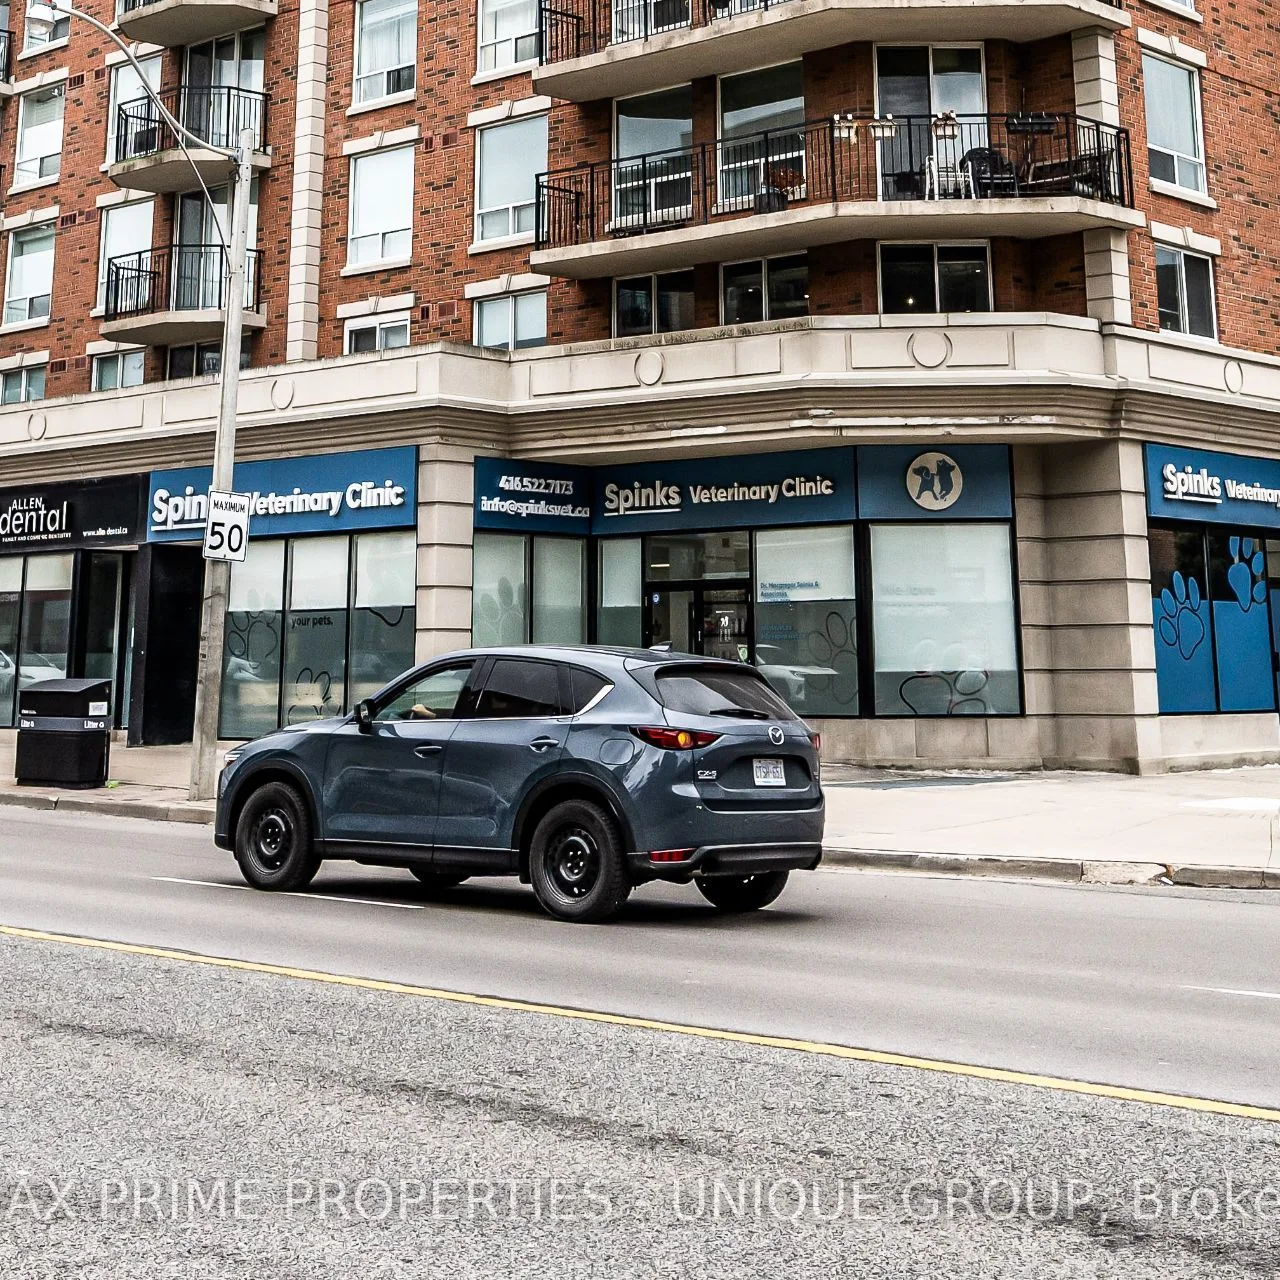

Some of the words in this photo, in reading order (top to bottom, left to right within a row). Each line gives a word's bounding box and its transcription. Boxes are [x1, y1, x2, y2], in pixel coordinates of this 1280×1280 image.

[499, 475, 573, 495] 416.522.7173
[1163, 463, 1222, 499] Spinks
[11, 496, 43, 511] ALLEN
[152, 484, 212, 529] Spin
[345, 480, 405, 509] Clinic
[213, 498, 246, 514] MAXIMUM
[481, 495, 590, 517] info@spinksvet.ca
[605, 480, 681, 514] Spinks
[689, 482, 779, 503] Veterinary
[782, 476, 834, 497] Clinic
[208, 521, 244, 553] 50
[292, 616, 310, 629] your
[312, 615, 333, 629] pets.
